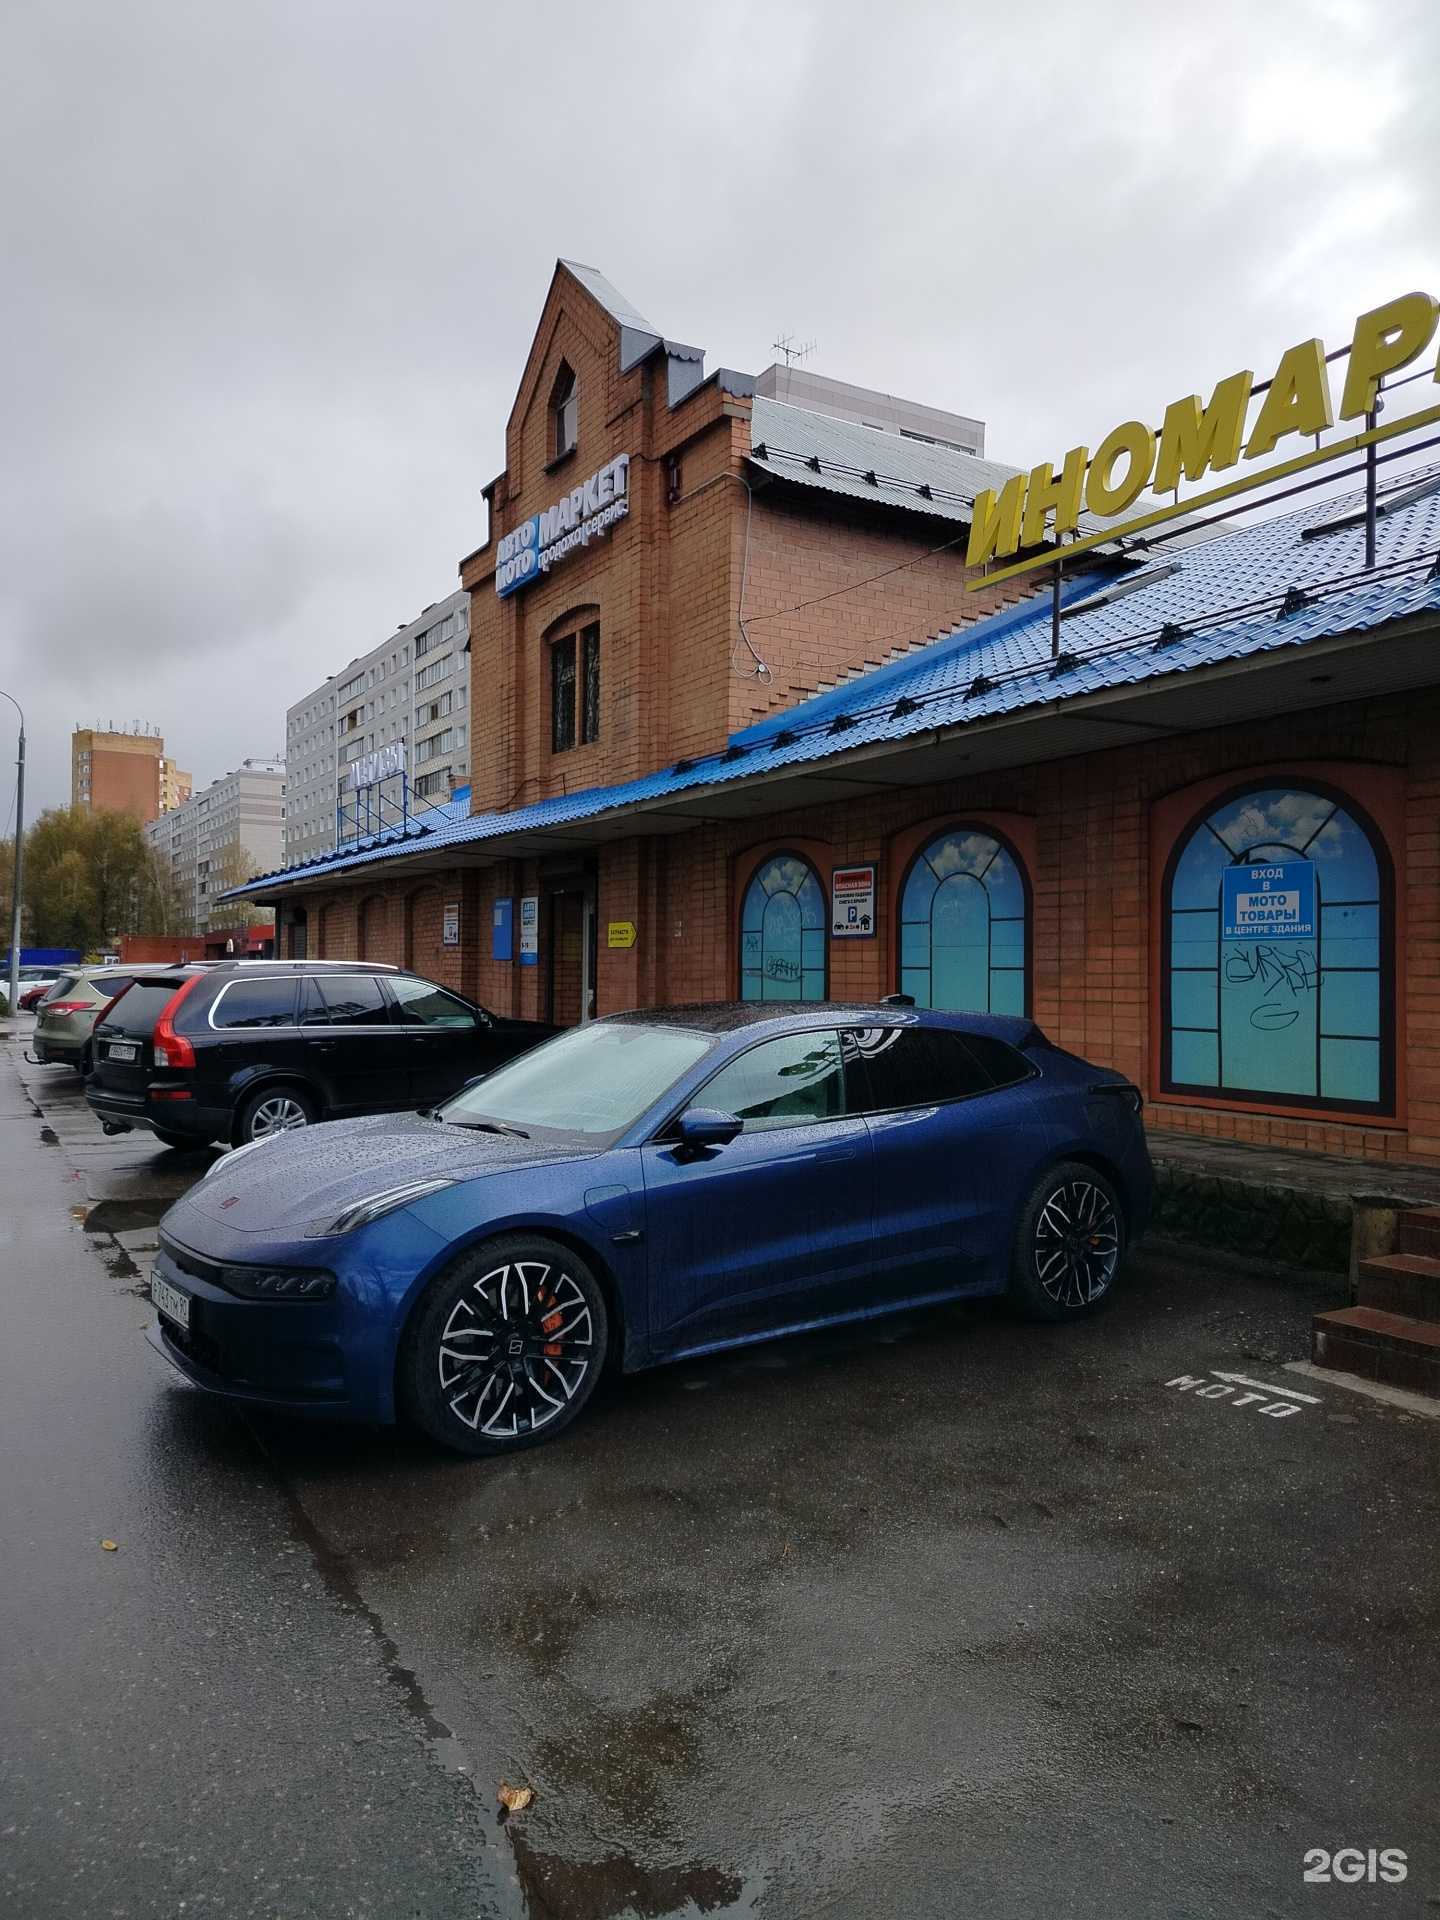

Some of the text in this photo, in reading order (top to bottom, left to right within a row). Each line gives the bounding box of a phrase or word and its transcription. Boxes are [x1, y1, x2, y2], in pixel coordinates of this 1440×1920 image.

[965, 292, 1440, 568] ИНОМАР
[538, 453, 630, 548] МАРКЕТ
[1251, 867, 1284, 880] ВХОД
[1263, 881, 1271, 891] В
[1248, 895, 1287, 907] МОТО
[1239, 908, 1297, 922] ТОВАРЫ
[1225, 923, 1312, 935] В ЦЕНТРЕ ЗДАНИЯ
[1164, 1375, 1302, 1418] МОТО
